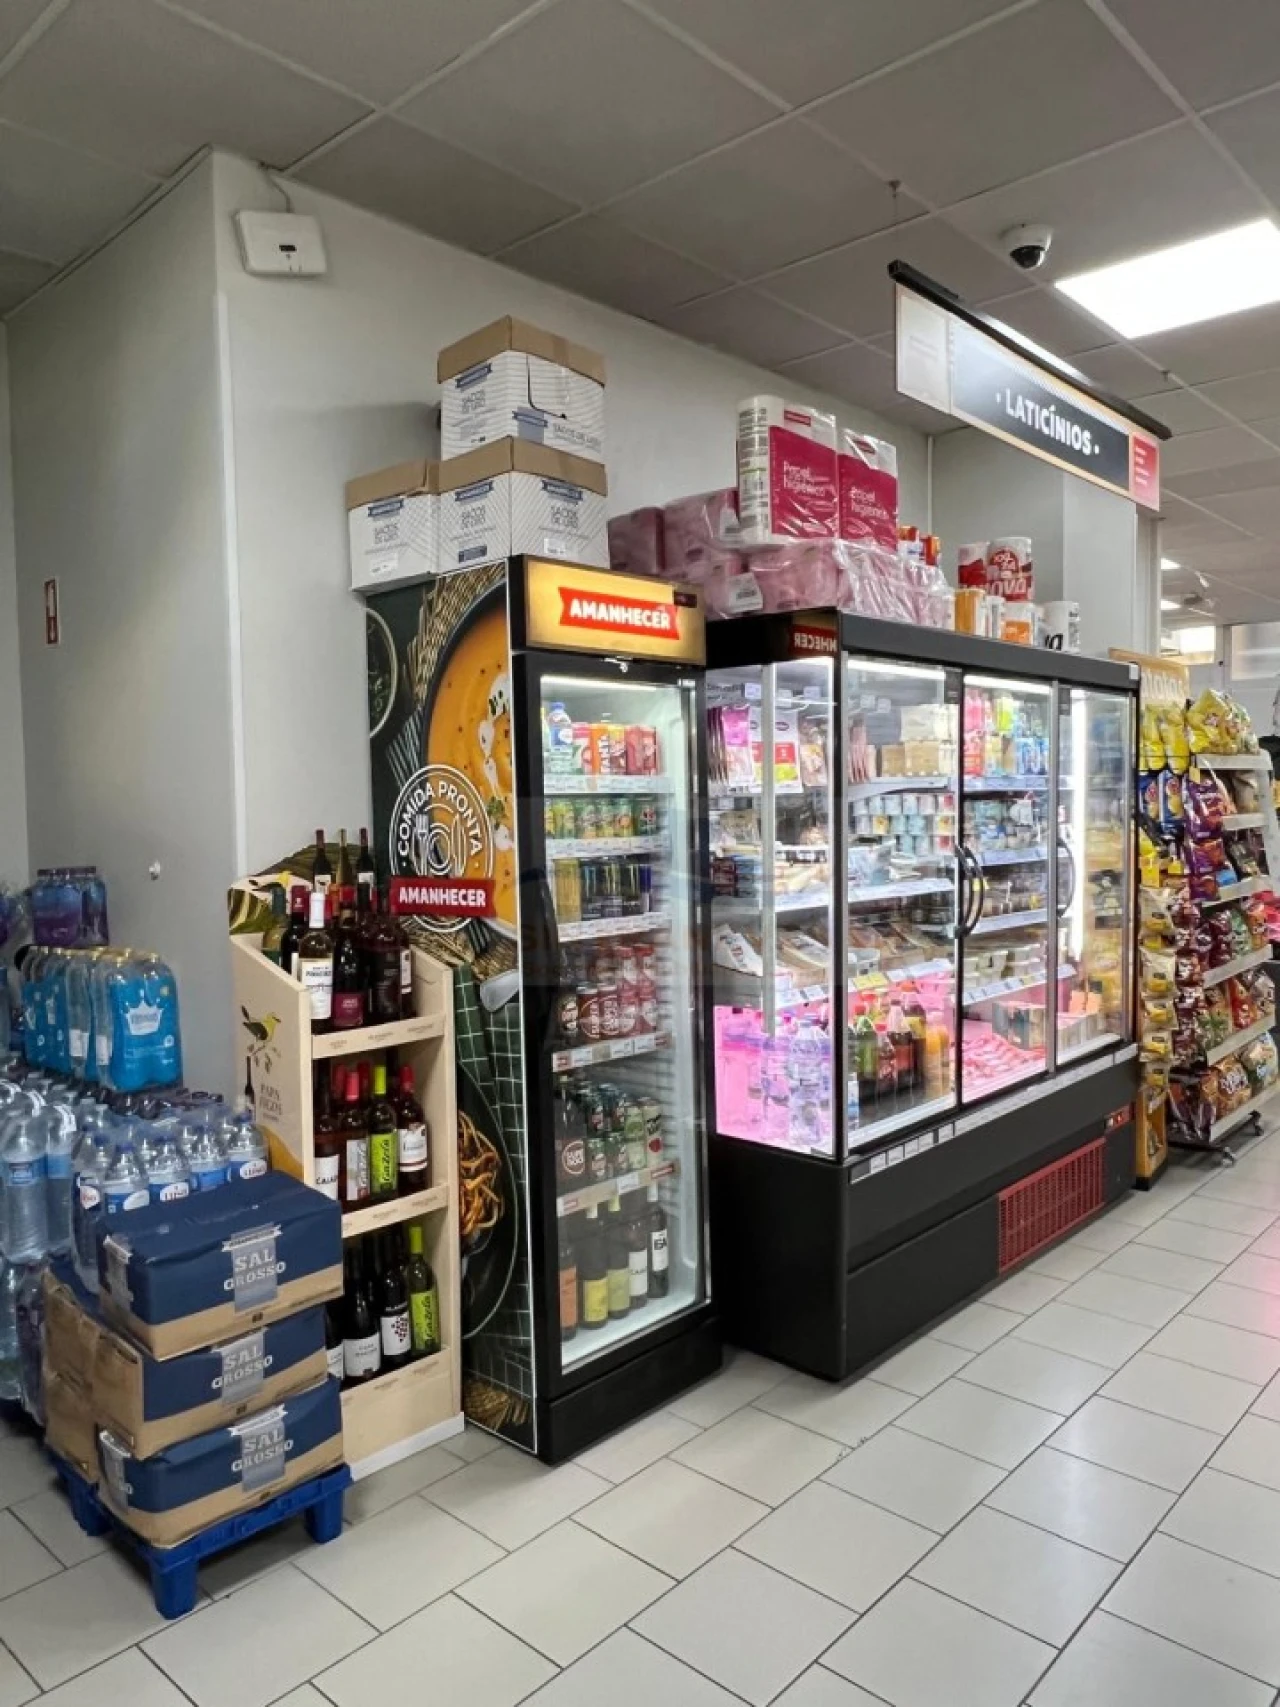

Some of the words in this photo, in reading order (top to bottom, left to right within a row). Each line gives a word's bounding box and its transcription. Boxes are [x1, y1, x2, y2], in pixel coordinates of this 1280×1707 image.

[1005, 388, 1092, 456] LATICÍNIOS
[569, 598, 671, 630] AMANHECER
[397, 781, 436, 857] COMIDA
[438, 780, 483, 857] PRONTA
[399, 886, 487, 908] AMANHECER
[235, 1248, 273, 1272] SAL
[223, 1261, 287, 1291] GROSSO
[211, 1354, 273, 1389] GROSSO
[223, 1344, 262, 1371] SAL
[230, 1439, 295, 1472] GROSSO
[243, 1428, 284, 1453] SAL
